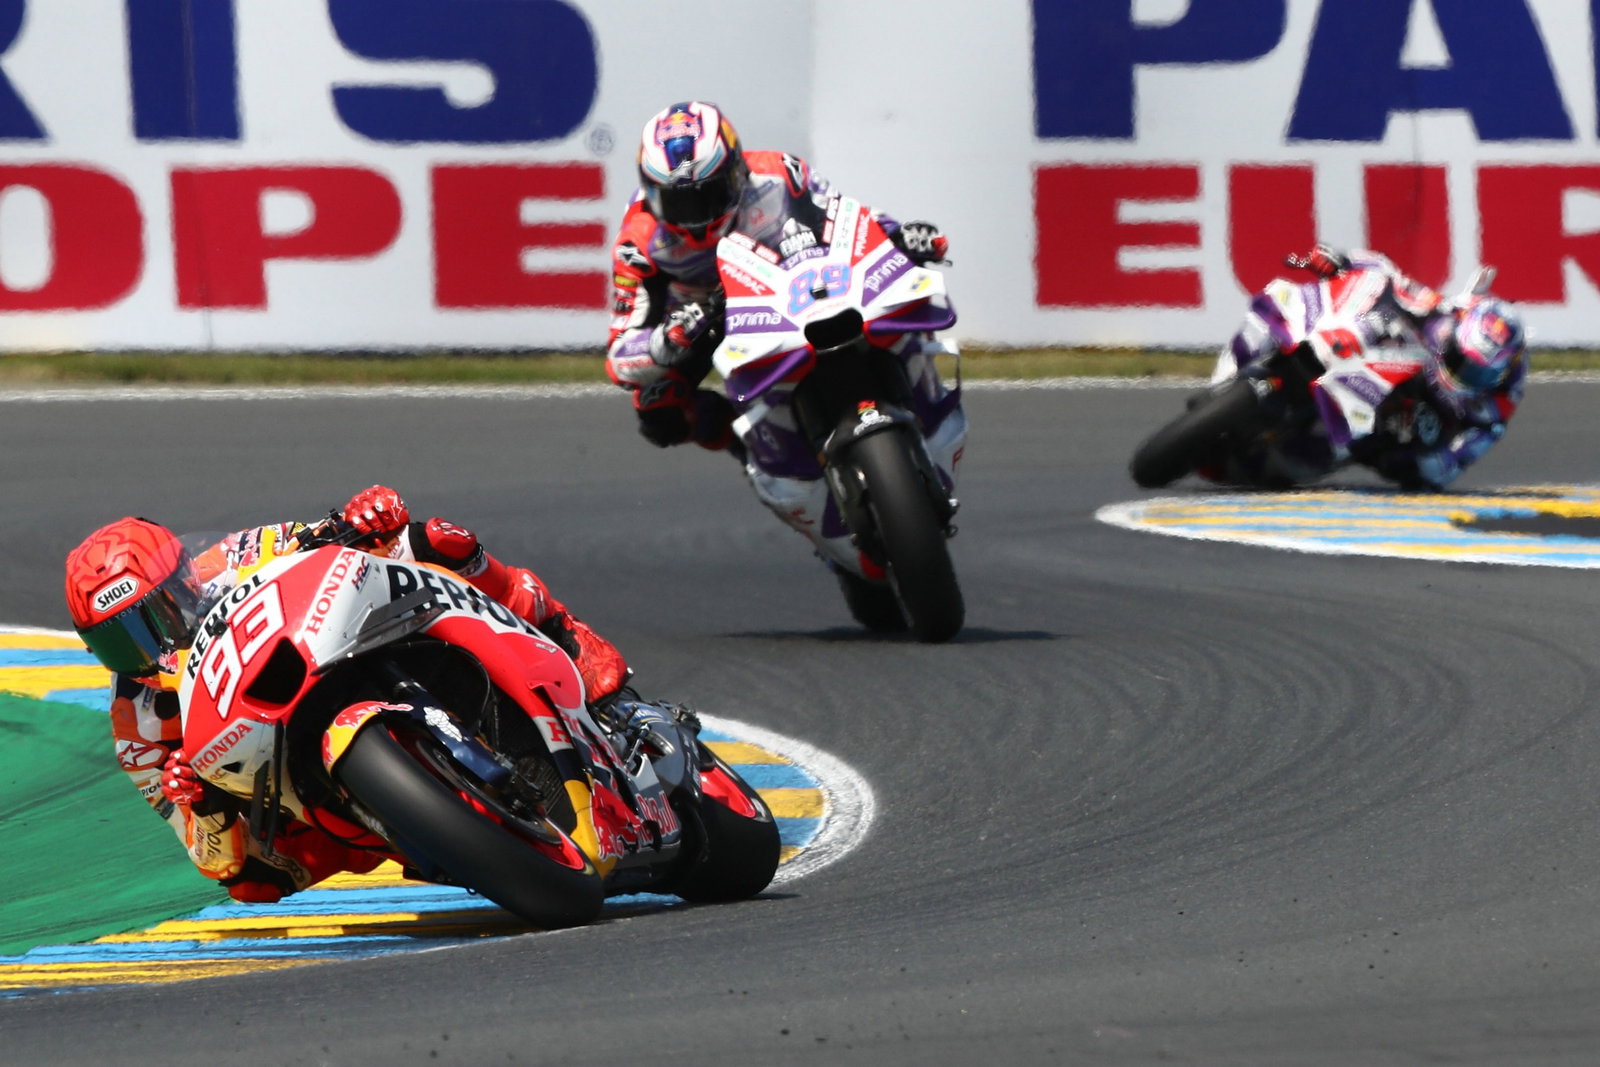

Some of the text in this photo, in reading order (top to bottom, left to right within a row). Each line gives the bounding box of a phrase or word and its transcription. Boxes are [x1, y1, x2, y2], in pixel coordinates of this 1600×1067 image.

[787, 263, 852, 318] 89
[865, 252, 908, 293] prima
[726, 312, 782, 331] prima
[97, 581, 133, 608] SHOEI
[306, 550, 357, 636] HONDA
[201, 580, 287, 721] 93
[193, 722, 254, 773] HONDA
